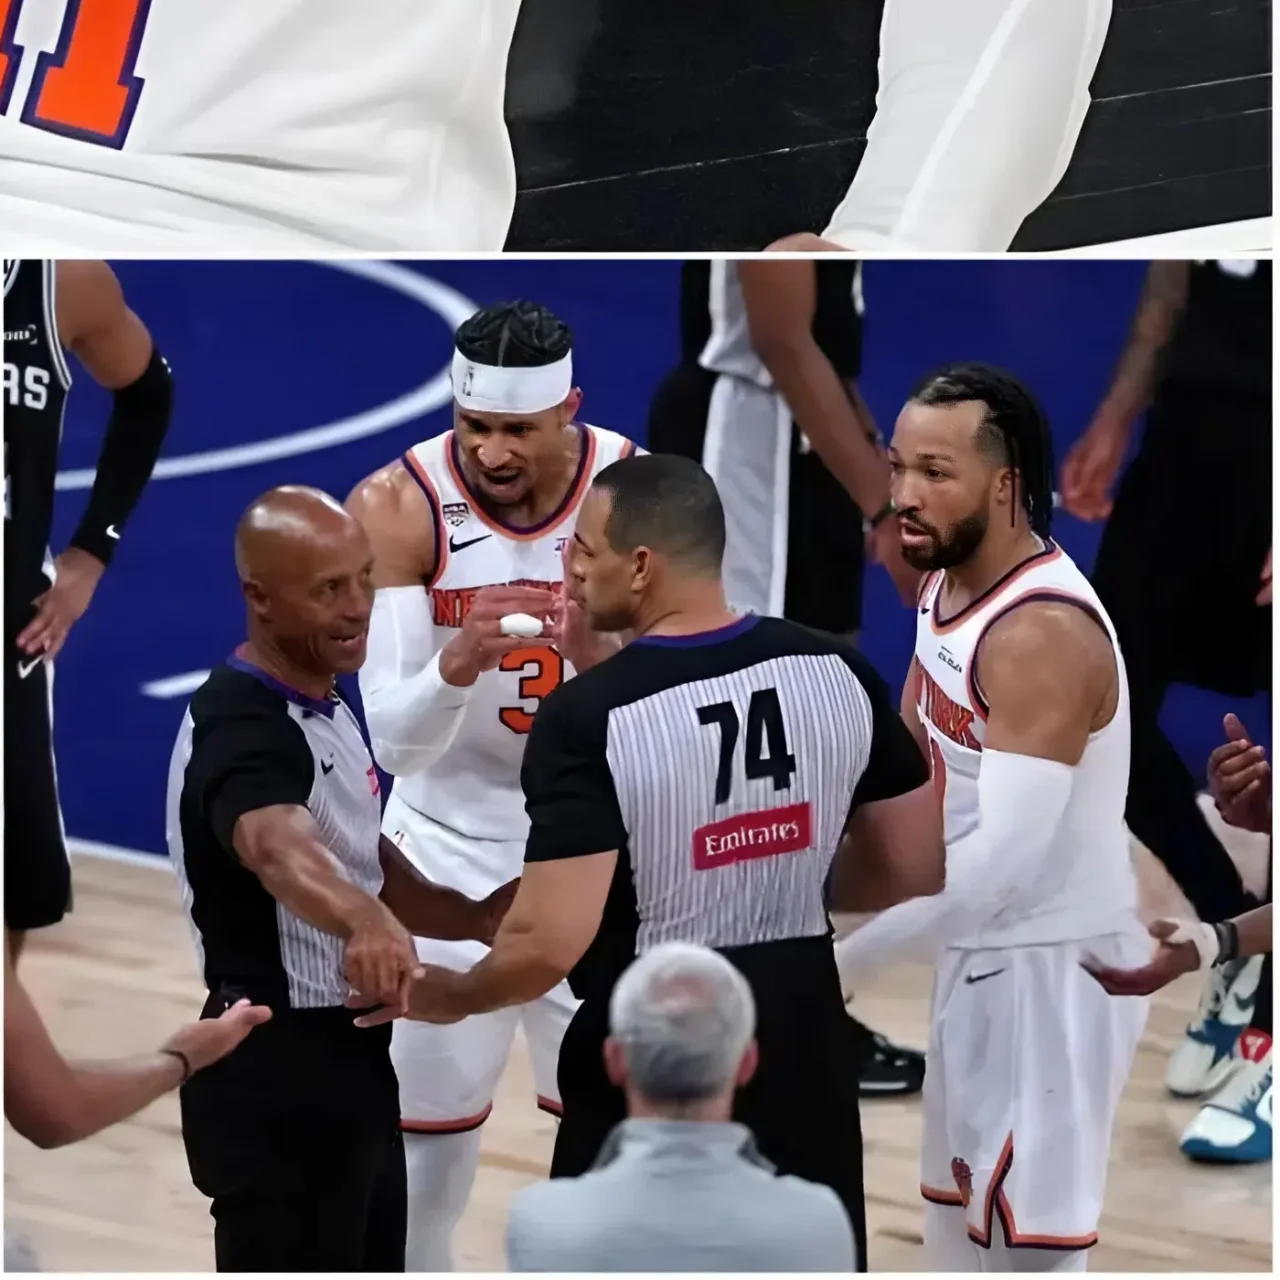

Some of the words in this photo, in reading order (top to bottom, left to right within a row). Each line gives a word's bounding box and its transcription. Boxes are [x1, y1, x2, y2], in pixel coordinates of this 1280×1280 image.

[499, 645, 563, 734] 3
[696, 687, 796, 805] 74
[705, 820, 799, 856] Emirates
